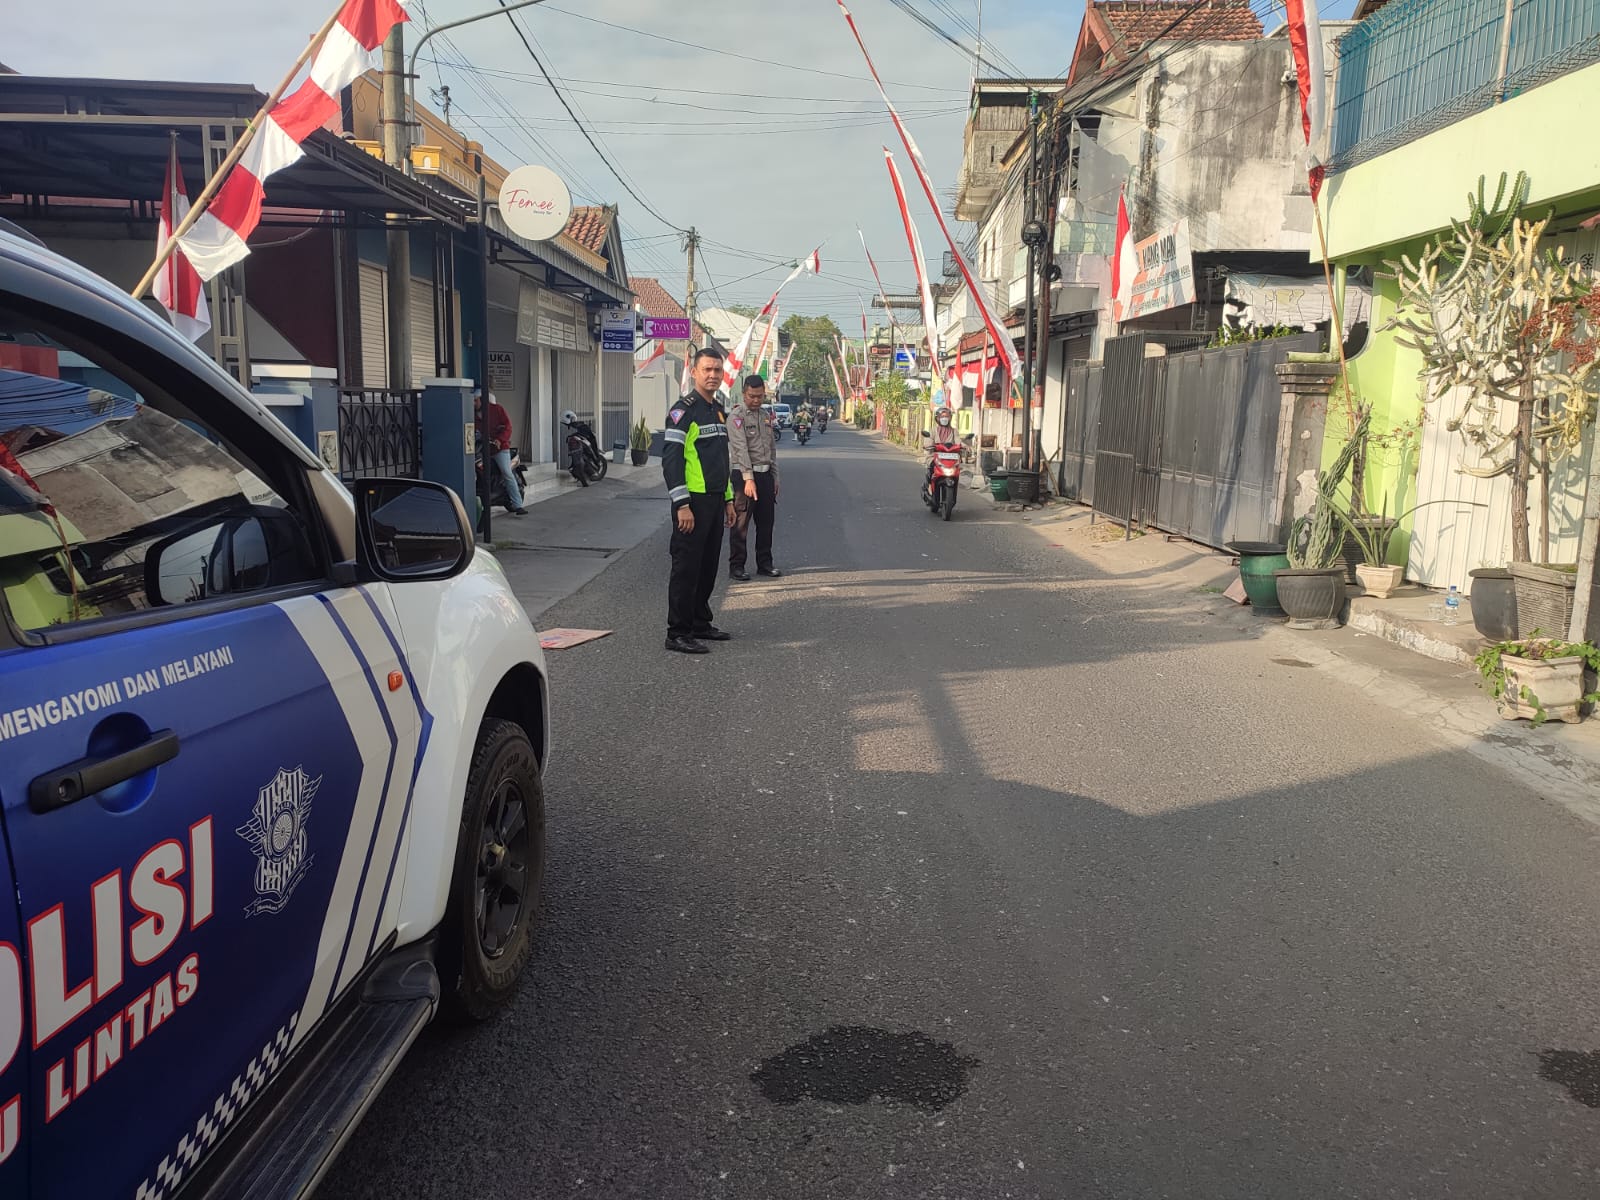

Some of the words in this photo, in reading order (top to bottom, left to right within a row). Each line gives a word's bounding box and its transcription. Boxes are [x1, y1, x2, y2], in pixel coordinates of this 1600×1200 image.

[488, 353, 511, 362] UKA
[0, 681, 122, 741] MENGAYOMI
[122, 669, 160, 699] DAN
[162, 646, 234, 686] MELAYANI
[46, 953, 199, 1123] LINTAS
